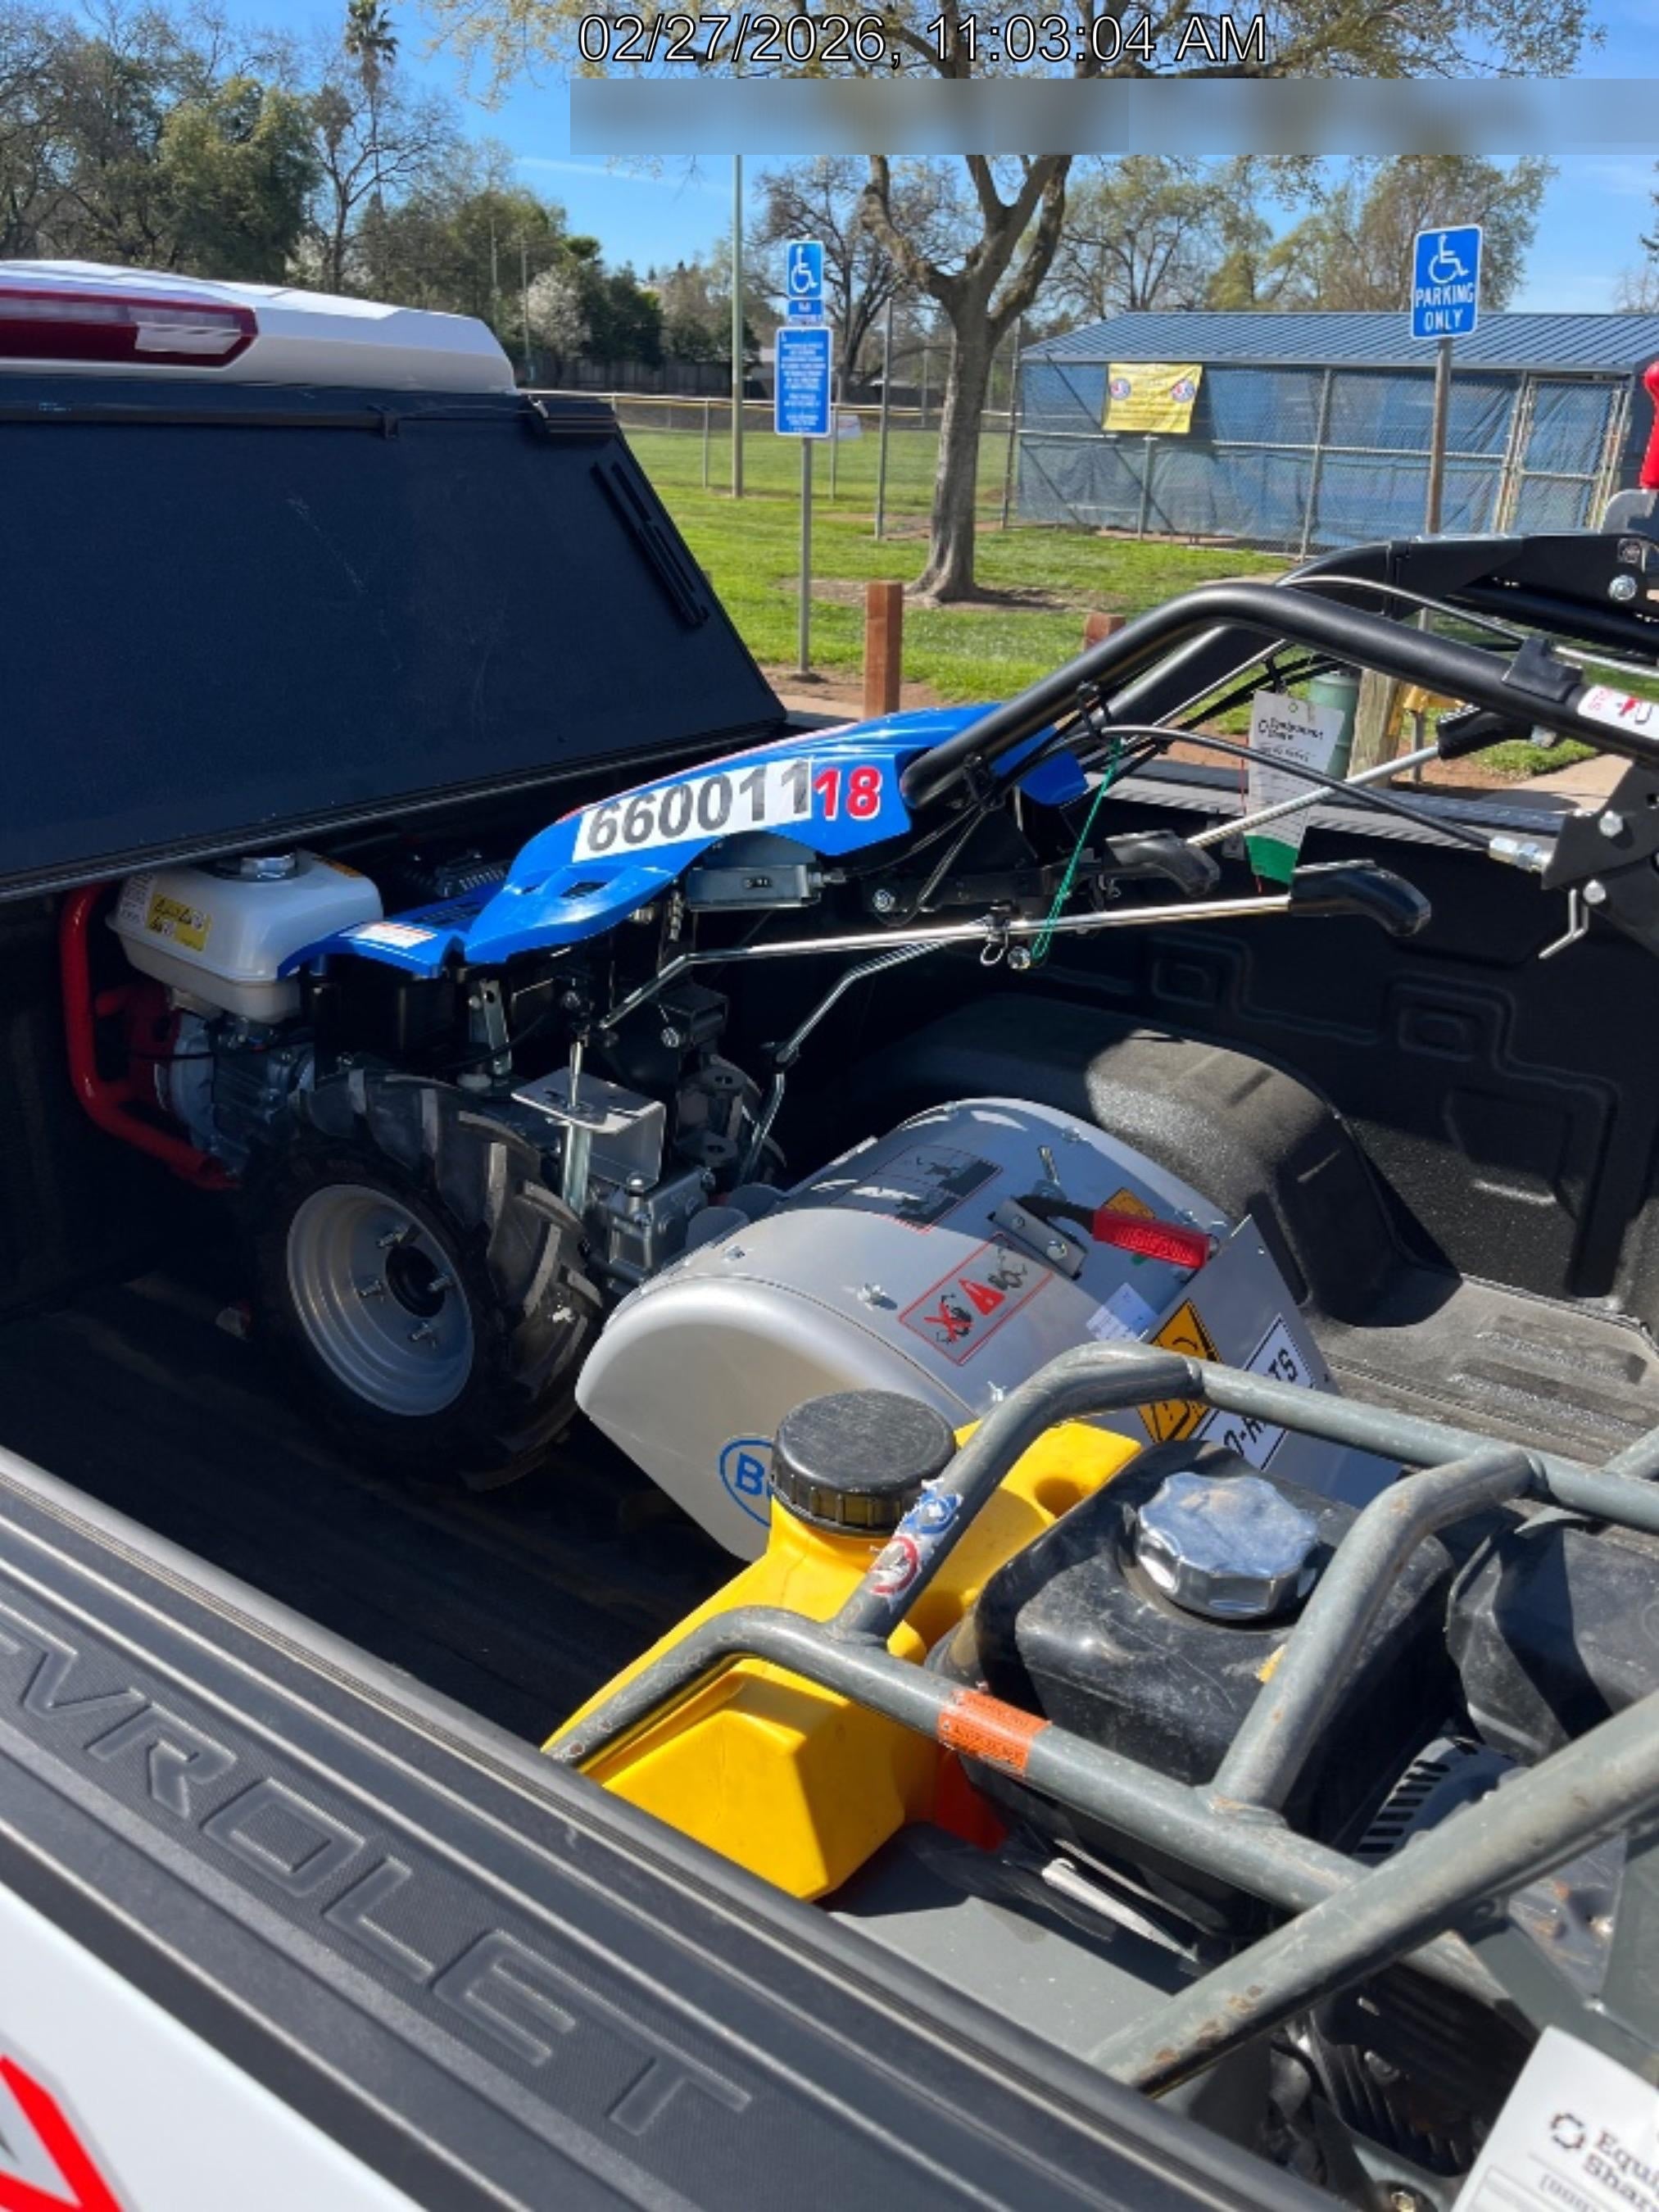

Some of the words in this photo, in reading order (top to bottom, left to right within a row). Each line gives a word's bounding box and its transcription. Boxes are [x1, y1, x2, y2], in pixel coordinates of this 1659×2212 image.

[1415, 282, 1474, 308] PARKING
[1423, 308, 1463, 333] ONLY
[587, 757, 809, 853] 660011
[813, 764, 883, 822] 18
